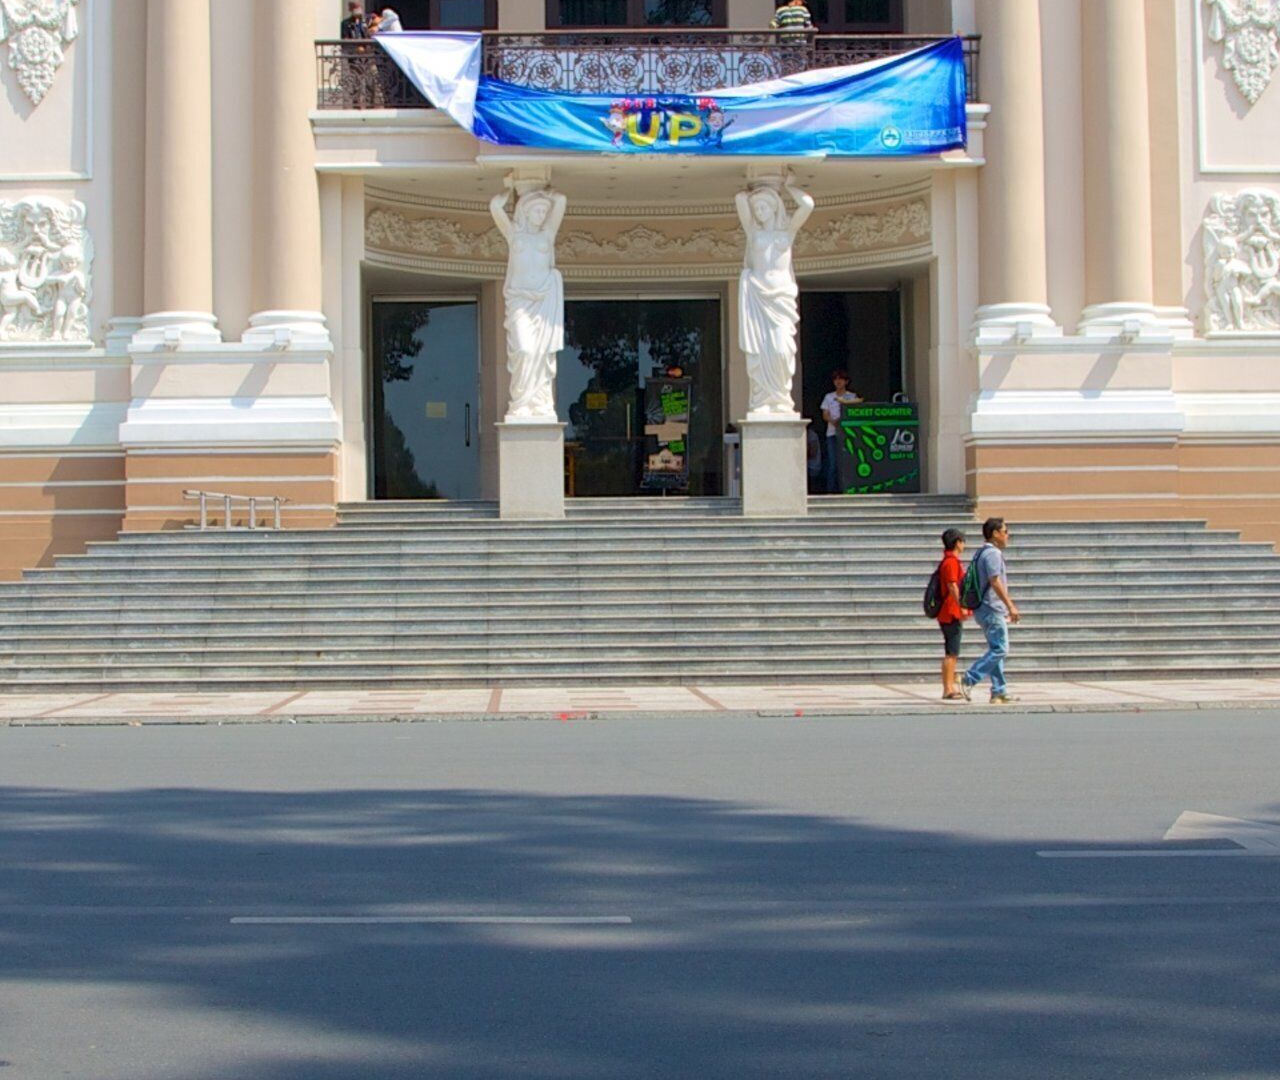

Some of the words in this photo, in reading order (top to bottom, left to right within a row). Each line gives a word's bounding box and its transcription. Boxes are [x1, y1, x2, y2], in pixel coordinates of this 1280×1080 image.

[626, 111, 702, 147] UP
[847, 408, 873, 416] TICKET
[874, 408, 913, 416] COUNTER
